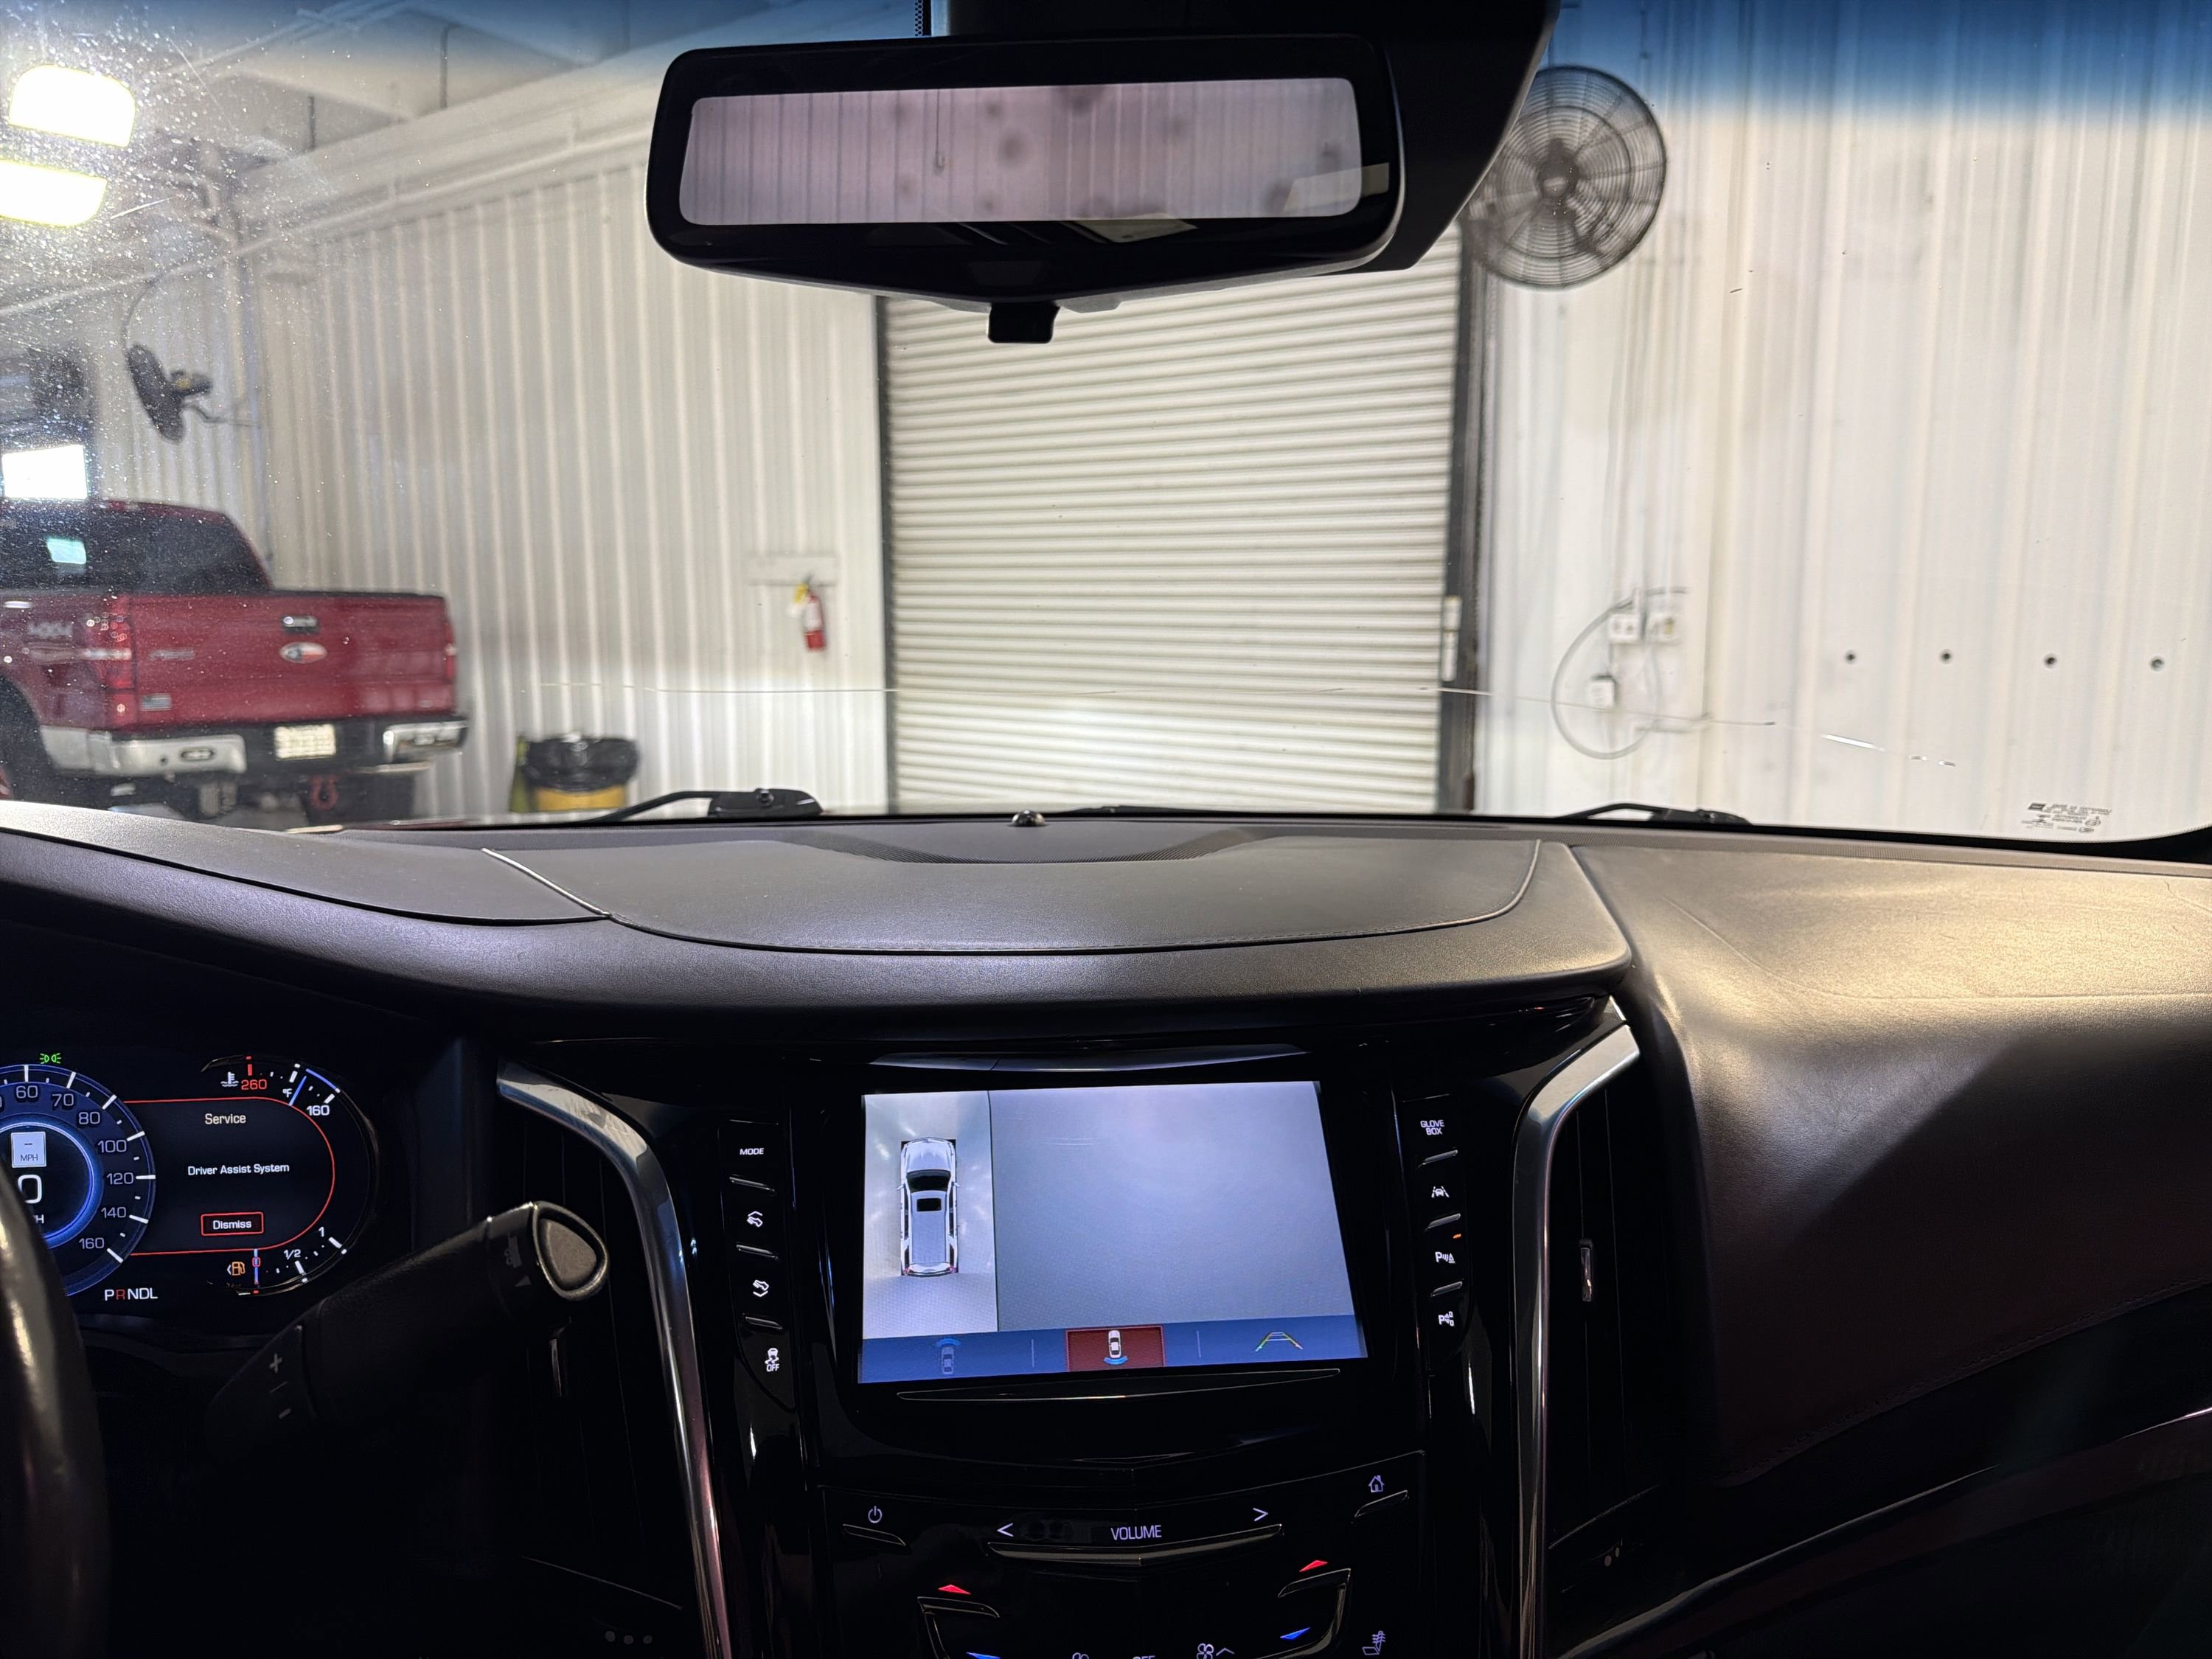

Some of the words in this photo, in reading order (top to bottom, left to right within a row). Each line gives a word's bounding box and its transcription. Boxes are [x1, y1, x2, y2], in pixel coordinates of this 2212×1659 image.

[241, 1079, 268, 1090] 260
[16, 1085, 38, 1099] 60
[52, 1093, 74, 1107] 70
[306, 1105, 330, 1116] 160
[78, 1111, 100, 1125] 80
[204, 1113, 246, 1124] Service
[1426, 1127, 1443, 1135] BOX
[97, 1139, 127, 1152] 100
[740, 1147, 765, 1155] MODE
[20, 1154, 38, 1162] MPH
[187, 1166, 218, 1175] Driver
[220, 1164, 251, 1174] Assist
[253, 1163, 290, 1175] System
[106, 1172, 134, 1186] 120
[100, 1206, 127, 1219] 140
[212, 1220, 252, 1230] Dismiss
[318, 1226, 324, 1237] 1
[78, 1237, 105, 1250] 160
[283, 1249, 301, 1260] 1/2
[766, 1363, 779, 1372] OFF
[1110, 1525, 1162, 1540] VOLUME
